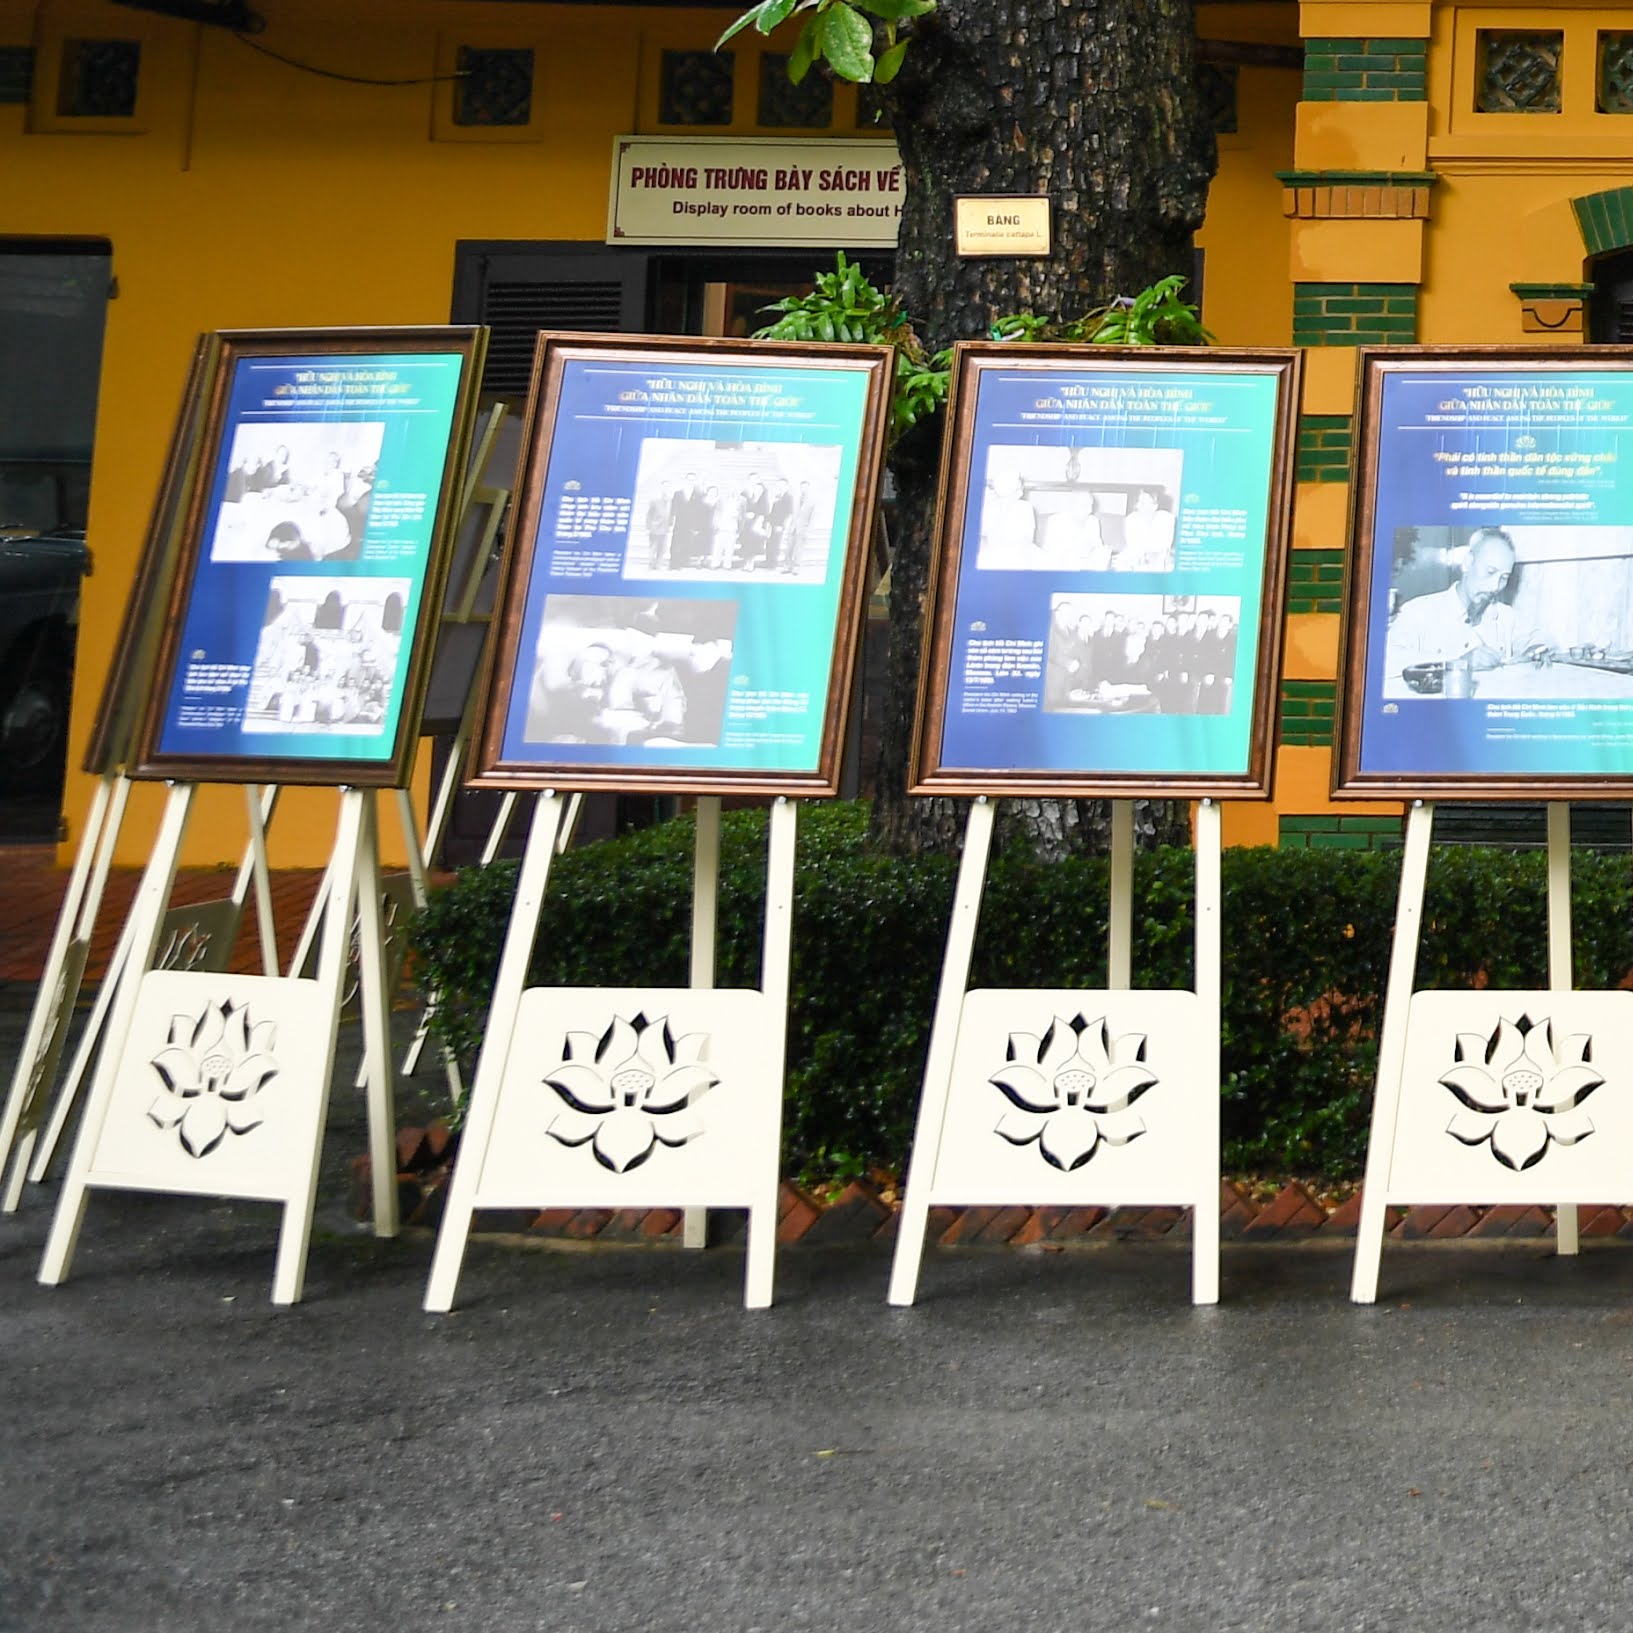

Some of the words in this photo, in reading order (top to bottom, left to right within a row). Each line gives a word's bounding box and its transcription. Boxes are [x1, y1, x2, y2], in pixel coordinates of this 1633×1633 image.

[631, 162, 698, 189] PHÒNG
[704, 166, 769, 190] TRƯNG
[775, 165, 814, 191] BÀY
[819, 166, 871, 191] SÁCH
[877, 164, 903, 192] VỀ
[672, 201, 729, 218] Display
[733, 205, 771, 216] room
[779, 203, 793, 216] of
[796, 203, 843, 217] books
[847, 203, 889, 217] about
